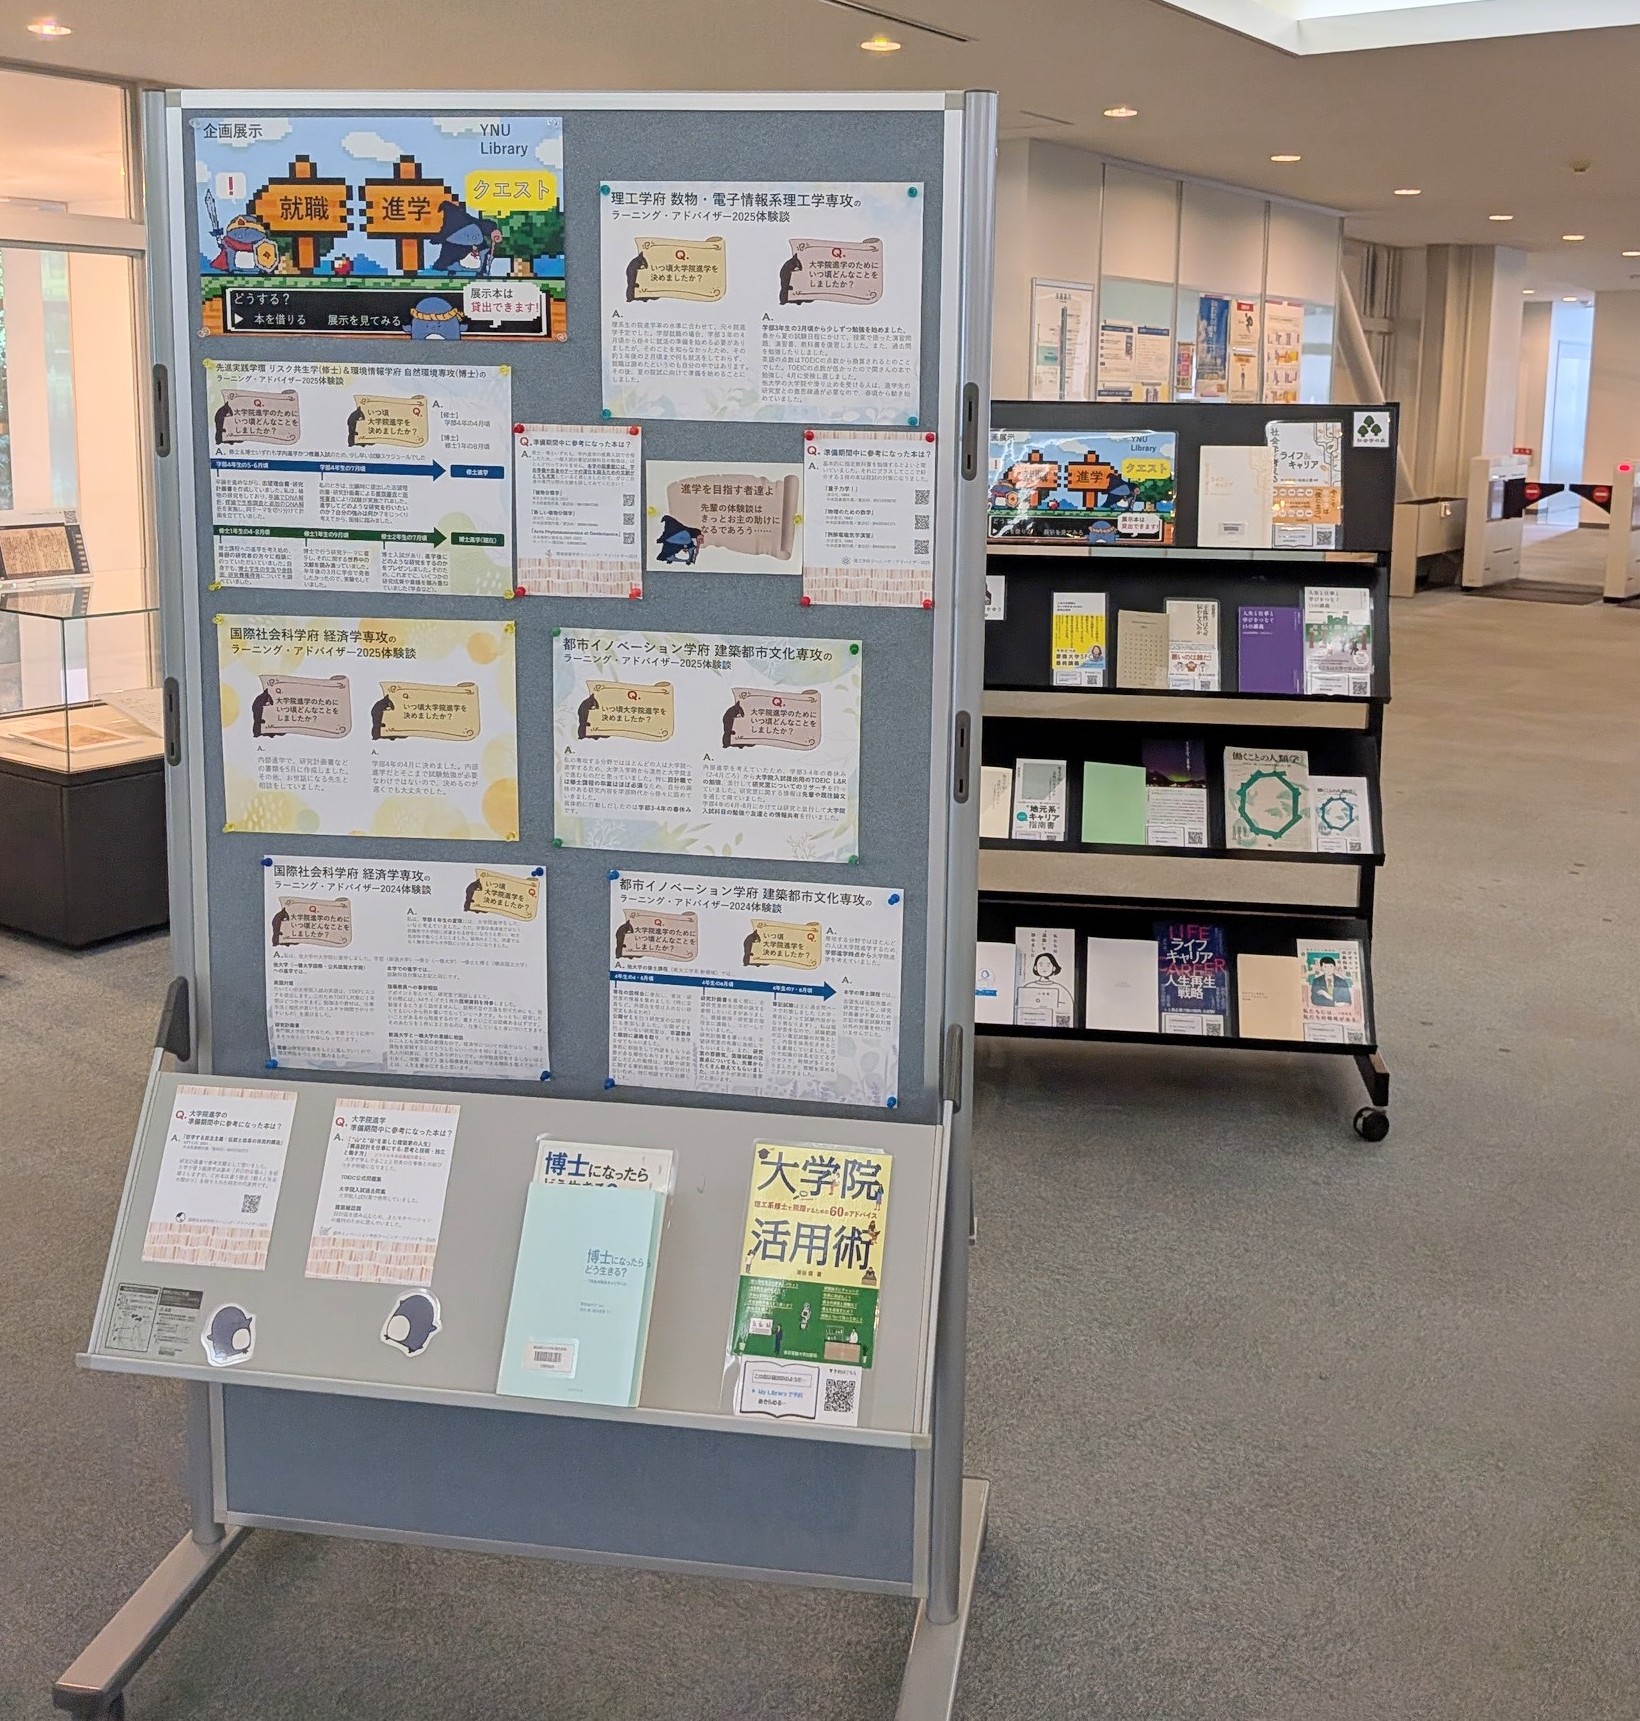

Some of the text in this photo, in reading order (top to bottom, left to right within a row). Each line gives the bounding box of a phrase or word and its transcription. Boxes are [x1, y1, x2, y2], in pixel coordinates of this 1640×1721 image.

[203, 123, 510, 139] 企画展示 YNU
[481, 142, 528, 157] Library
[473, 180, 550, 199] クエスト
[611, 192, 861, 208] 理工学府 数物・電子情報系理工学専攻の
[280, 196, 328, 221] 就職
[382, 196, 431, 221] 進学
[612, 210, 790, 223] ラーニング・アドバイザー2025体験談
[675, 250, 689, 260] Q.
[832, 248, 845, 258] Q.
[650, 265, 718, 273] いつ頃大学院進学を
[809, 261, 878, 270] 大学院進学のために
[809, 270, 878, 279] いつ頃どんなことを
[471, 288, 513, 299] 展示本は
[612, 310, 623, 318] A.
[762, 313, 773, 321] A.
[254, 313, 401, 326] 本を借りる 展示を見てみる
[216, 364, 266, 373] 先進実践学環
[216, 375, 344, 386] ラーニング・アドバイザー2025体験談
[254, 400, 264, 408] Q.
[432, 400, 443, 408] A.
[234, 408, 298, 416] 大学院進学のために
[368, 408, 389, 416] いつ頃
[412, 408, 422, 417] Q.
[234, 418, 298, 426] いつ頃どんなことを
[368, 418, 410, 426] 大学院進学を
[520, 437, 532, 446] Q.
[807, 446, 820, 456] Q.
[1126, 463, 1167, 473] クエスト
[1288, 461, 1318, 469] キャリア
[1077, 470, 1102, 483] 進学
[681, 483, 774, 497] 進学を目指す者達よ
[700, 504, 762, 514] 先輩の体験談は
[701, 515, 780, 525] きっとお主の助けに
[230, 628, 396, 644] 国際社会科学府 経済学専攻の
[231, 644, 416, 660] ラーニング・アドバイザー2025体験談
[563, 638, 832, 662] 都市イノベーション学府 建築都市文化専攻の
[564, 654, 731, 670] ラーニング・アドバイザー2025体験談
[627, 690, 641, 700] Q.
[276, 698, 338, 706] 大学院進学のために
[772, 697, 786, 707] Q.
[276, 706, 338, 714] いつ頃どんなことを
[404, 704, 467, 712] いつ頃大学院進学を
[601, 705, 666, 715] いつ頃大学院進学を
[750, 708, 816, 718] 大学院進学のために
[751, 718, 816, 727] いつ頃どんなことを
[1233, 752, 1300, 763] 働くことの人類学
[1029, 821, 1054, 829] 指南書
[274, 865, 430, 882] 国際社会科学府 経済学専攻の
[275, 880, 431, 895] ラーニング・アドバイザー2024体験談
[486, 880, 506, 890] いつ頃
[484, 889, 524, 901] 大学院進学を
[528, 888, 537, 898] Q.
[620, 878, 872, 906] 都市イノベーション学府 建築都市文化専攻の
[620, 894, 782, 914] ラーニング・アドバイザー2024体験談
[309, 906, 319, 914] Q.
[291, 914, 349, 923] 大学院進学のために
[291, 922, 349, 931] いつ頃どんなことを
[634, 926, 696, 937] 大学院進学のために
[763, 932, 784, 940] いつ頃
[806, 932, 816, 942] Q.
[1169, 925, 1209, 939] LIFE
[634, 936, 696, 945] いつ頃どんなことを
[1171, 938, 1207, 951] ライフ
[763, 942, 804, 950] 大学院進学を
[1167, 950, 1213, 963] キャリア
[842, 976, 852, 984] A.
[1165, 975, 1216, 988] 人生再生
[1178, 987, 1203, 999] 戦略
[176, 1110, 227, 1119] Q. 大学院進学の
[336, 1115, 386, 1127] Q. 大学院進学
[171, 1134, 180, 1142] A.
[334, 1133, 343, 1141] A.
[545, 1152, 648, 1182] 博士になったら
[758, 1152, 884, 1200] 大学院
[751, 1218, 871, 1270] 活用術
[587, 1249, 643, 1267] 博士になったら
